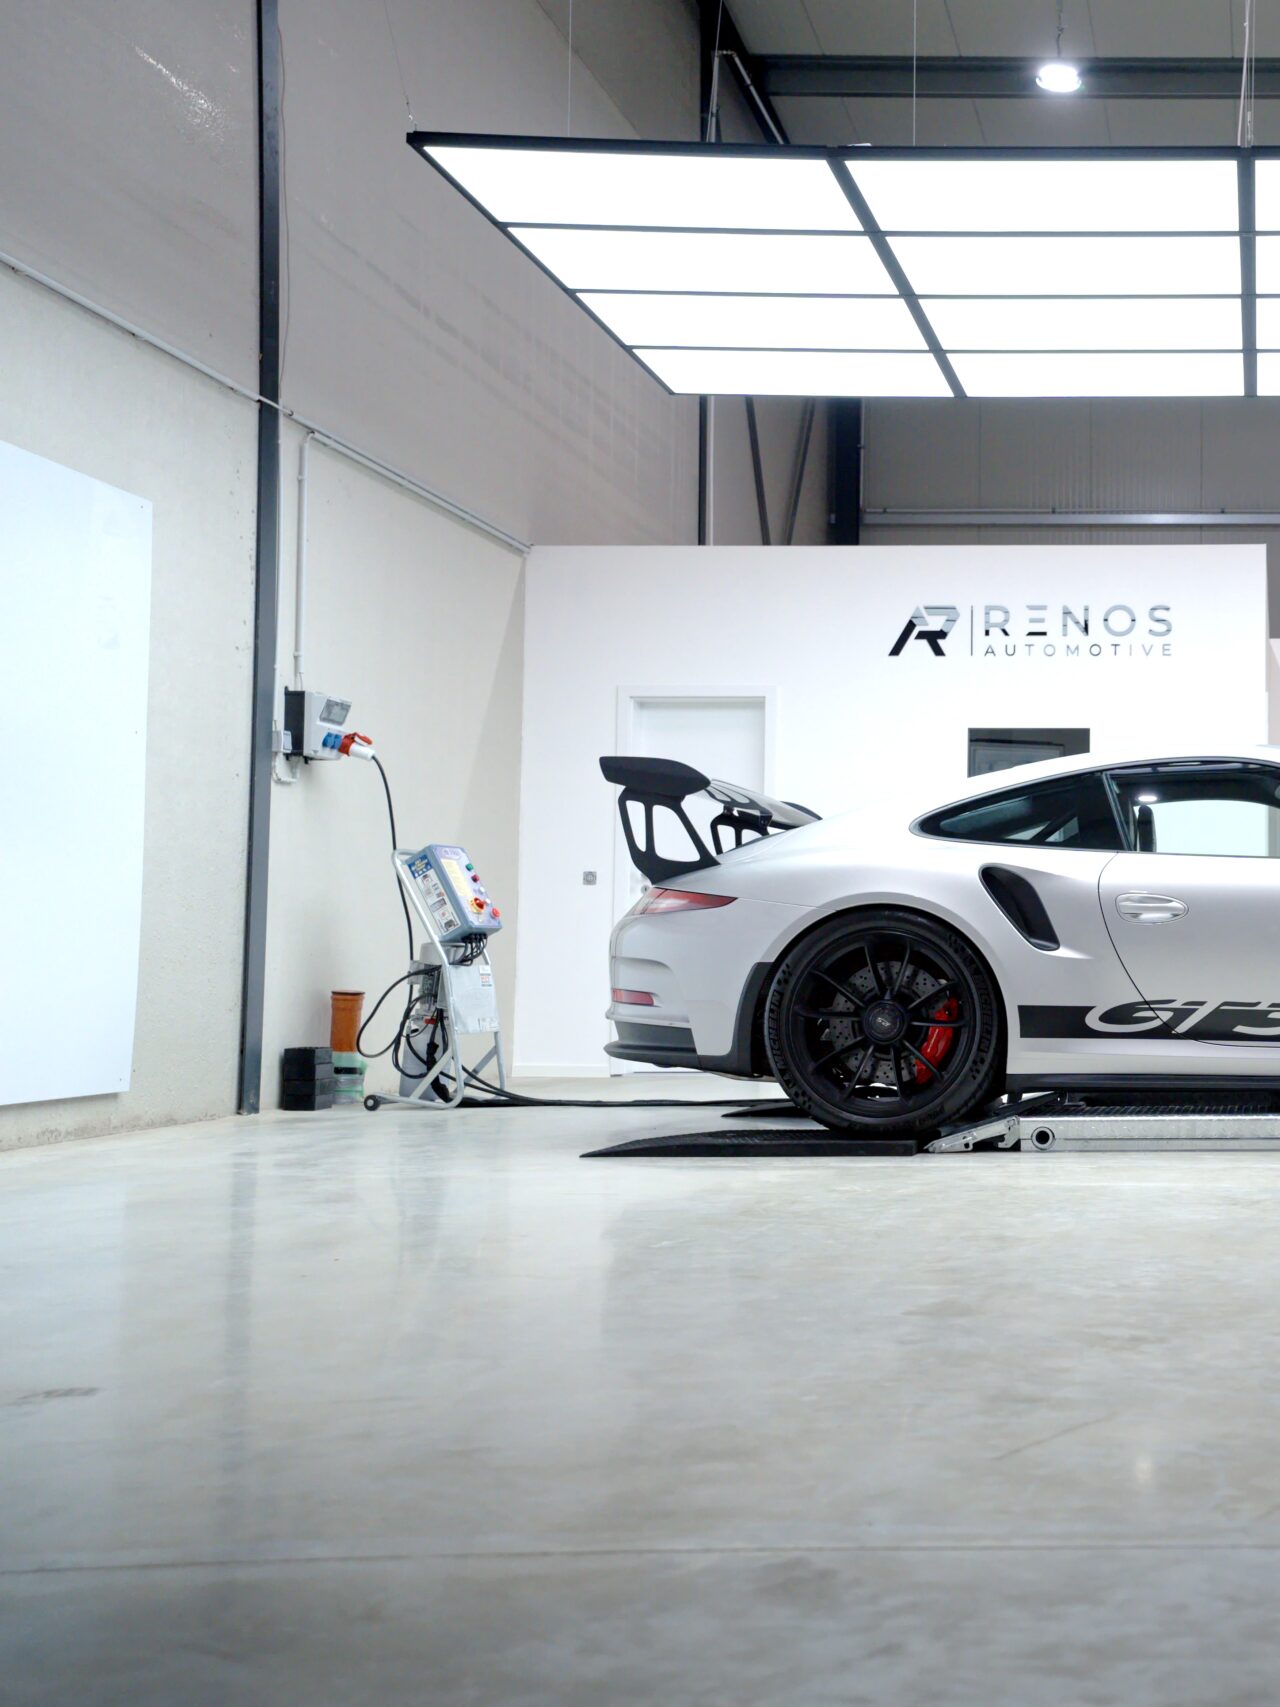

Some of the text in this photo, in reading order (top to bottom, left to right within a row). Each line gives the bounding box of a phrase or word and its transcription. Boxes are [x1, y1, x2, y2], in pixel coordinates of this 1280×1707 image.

[984, 604, 1173, 637] RENOS
[984, 643, 1172, 657] AUTOMOTIVE
[769, 990, 787, 1070] MICHELIN
